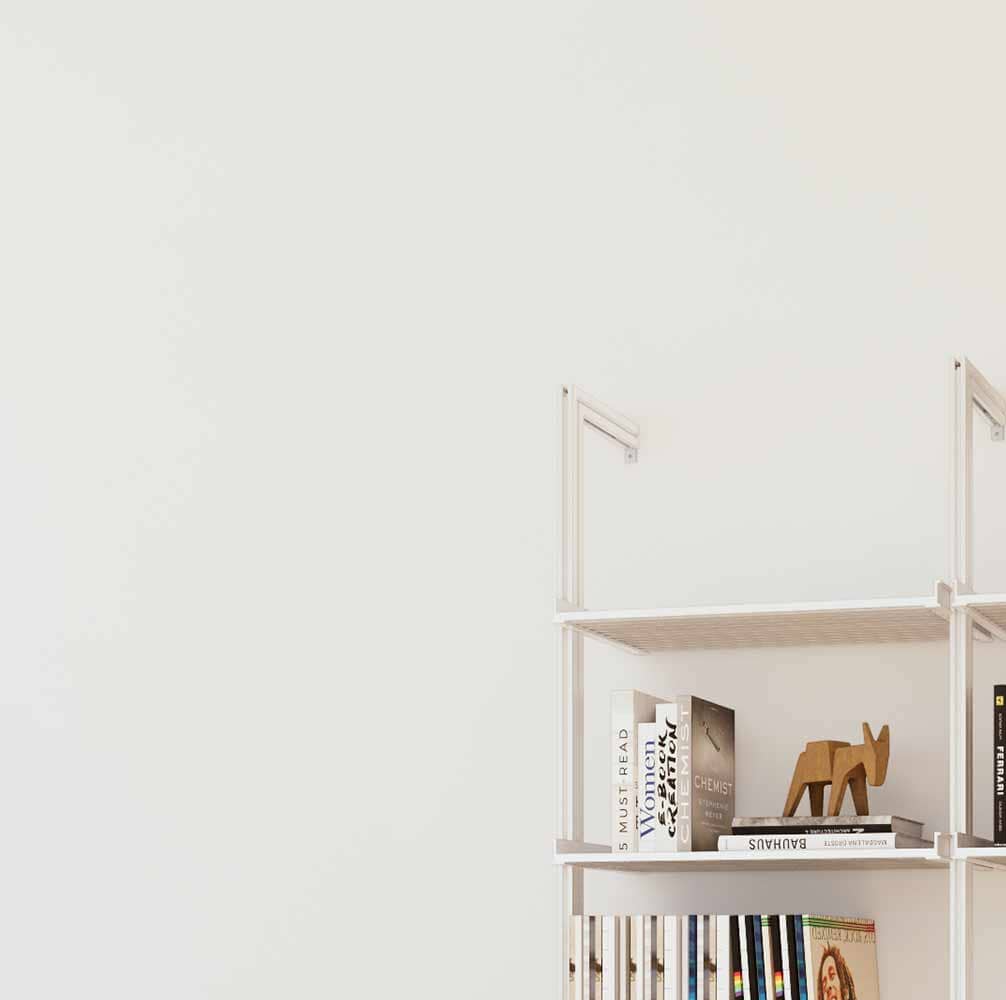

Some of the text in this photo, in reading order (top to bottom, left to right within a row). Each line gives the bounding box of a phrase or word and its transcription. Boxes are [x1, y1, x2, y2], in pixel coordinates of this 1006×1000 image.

[640, 741, 656, 838] Women
[666, 716, 678, 838] CREATION
[680, 705, 690, 843] CHEMIST
[694, 775, 733, 796] CHEMIST
[748, 838, 807, 850] BAUHAUS
